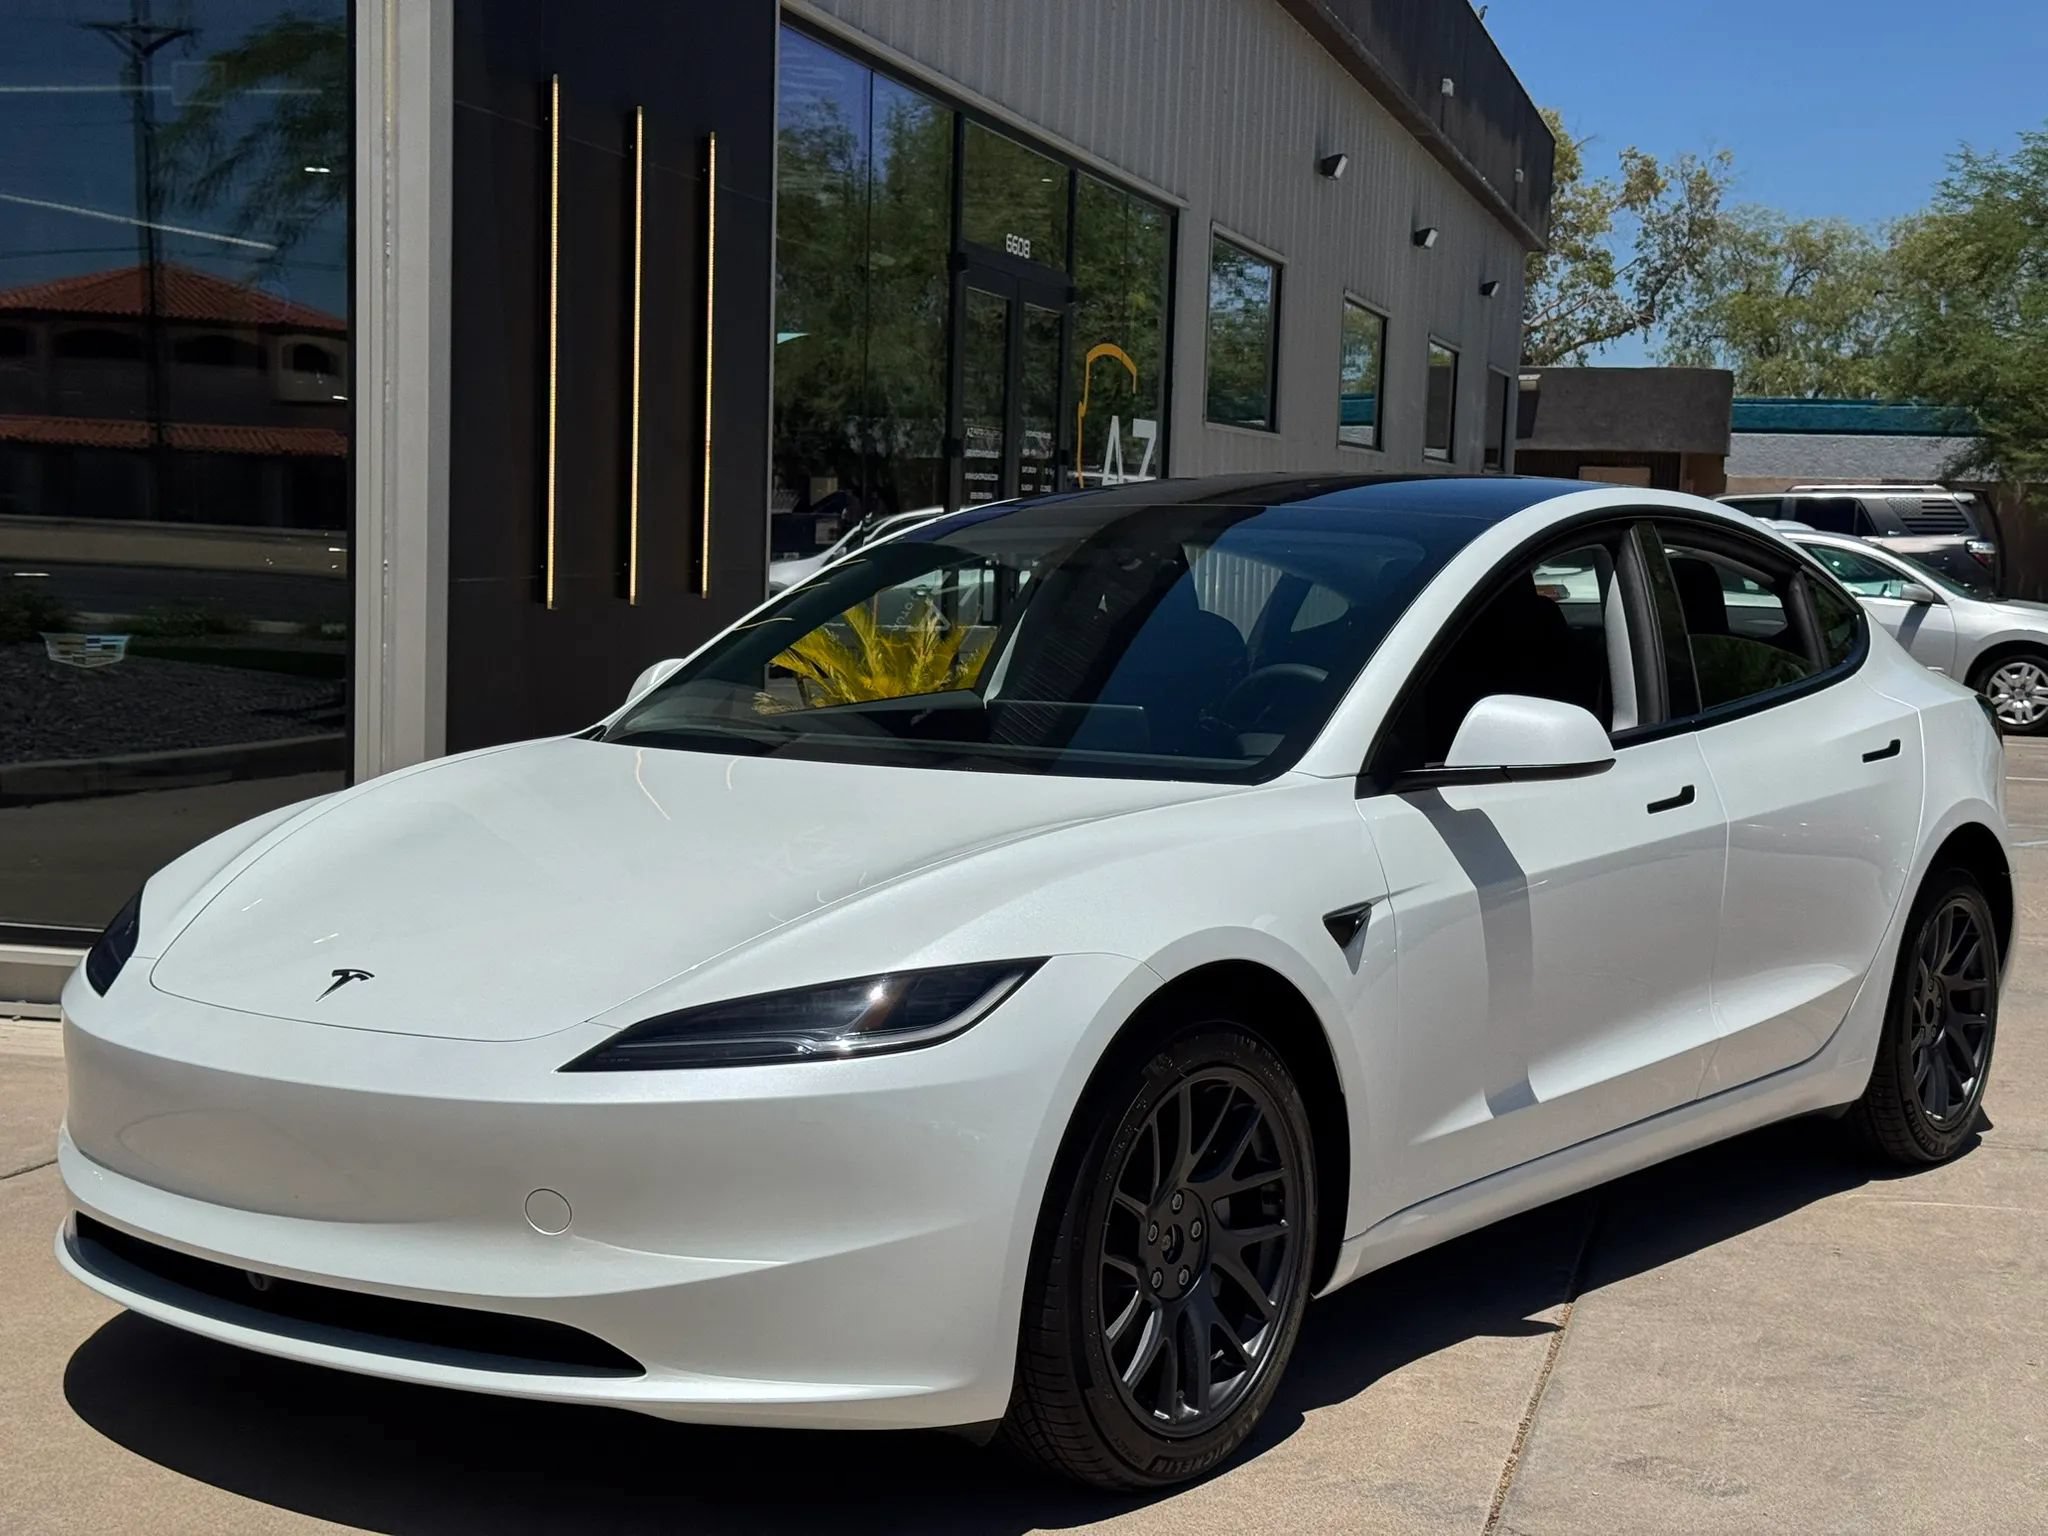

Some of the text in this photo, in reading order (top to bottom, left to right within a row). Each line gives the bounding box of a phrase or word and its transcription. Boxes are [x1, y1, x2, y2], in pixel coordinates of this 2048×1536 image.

[1006, 233, 1031, 259] 6608
[1101, 415, 1157, 486] AZ
[1152, 1436, 1234, 1474] MICHELIN
